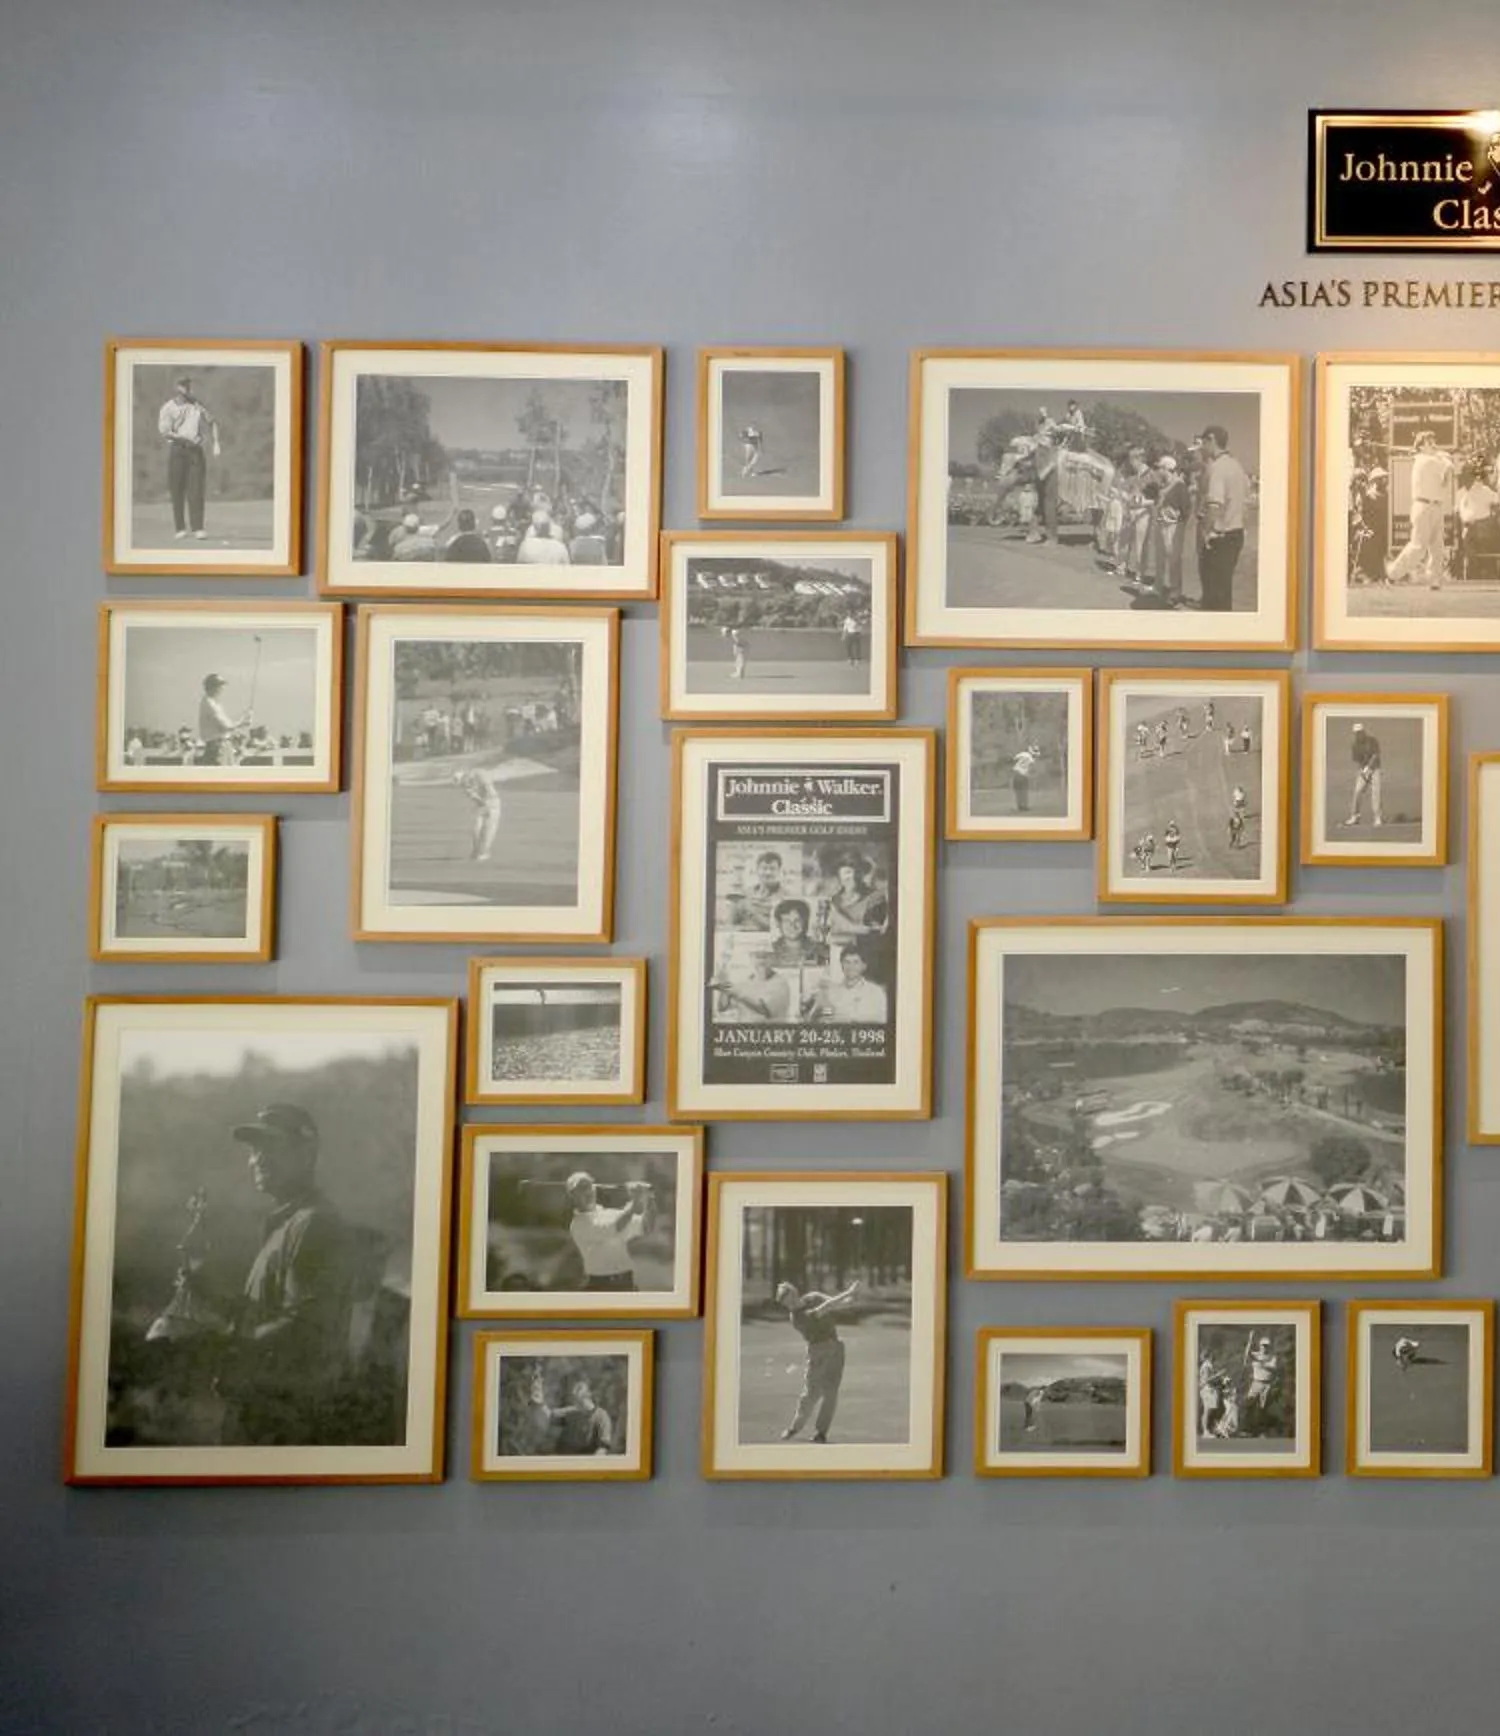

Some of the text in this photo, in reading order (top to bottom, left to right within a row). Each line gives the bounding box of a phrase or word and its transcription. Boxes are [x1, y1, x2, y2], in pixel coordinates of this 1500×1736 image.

[1339, 152, 1474, 184] Johnnie
[1258, 279, 1352, 308] ASIA'S
[725, 777, 800, 797] Johnnie
[771, 799, 833, 815] Classic
[713, 1029, 796, 1044] JANUARY
[851, 1029, 886, 1044] 1998
